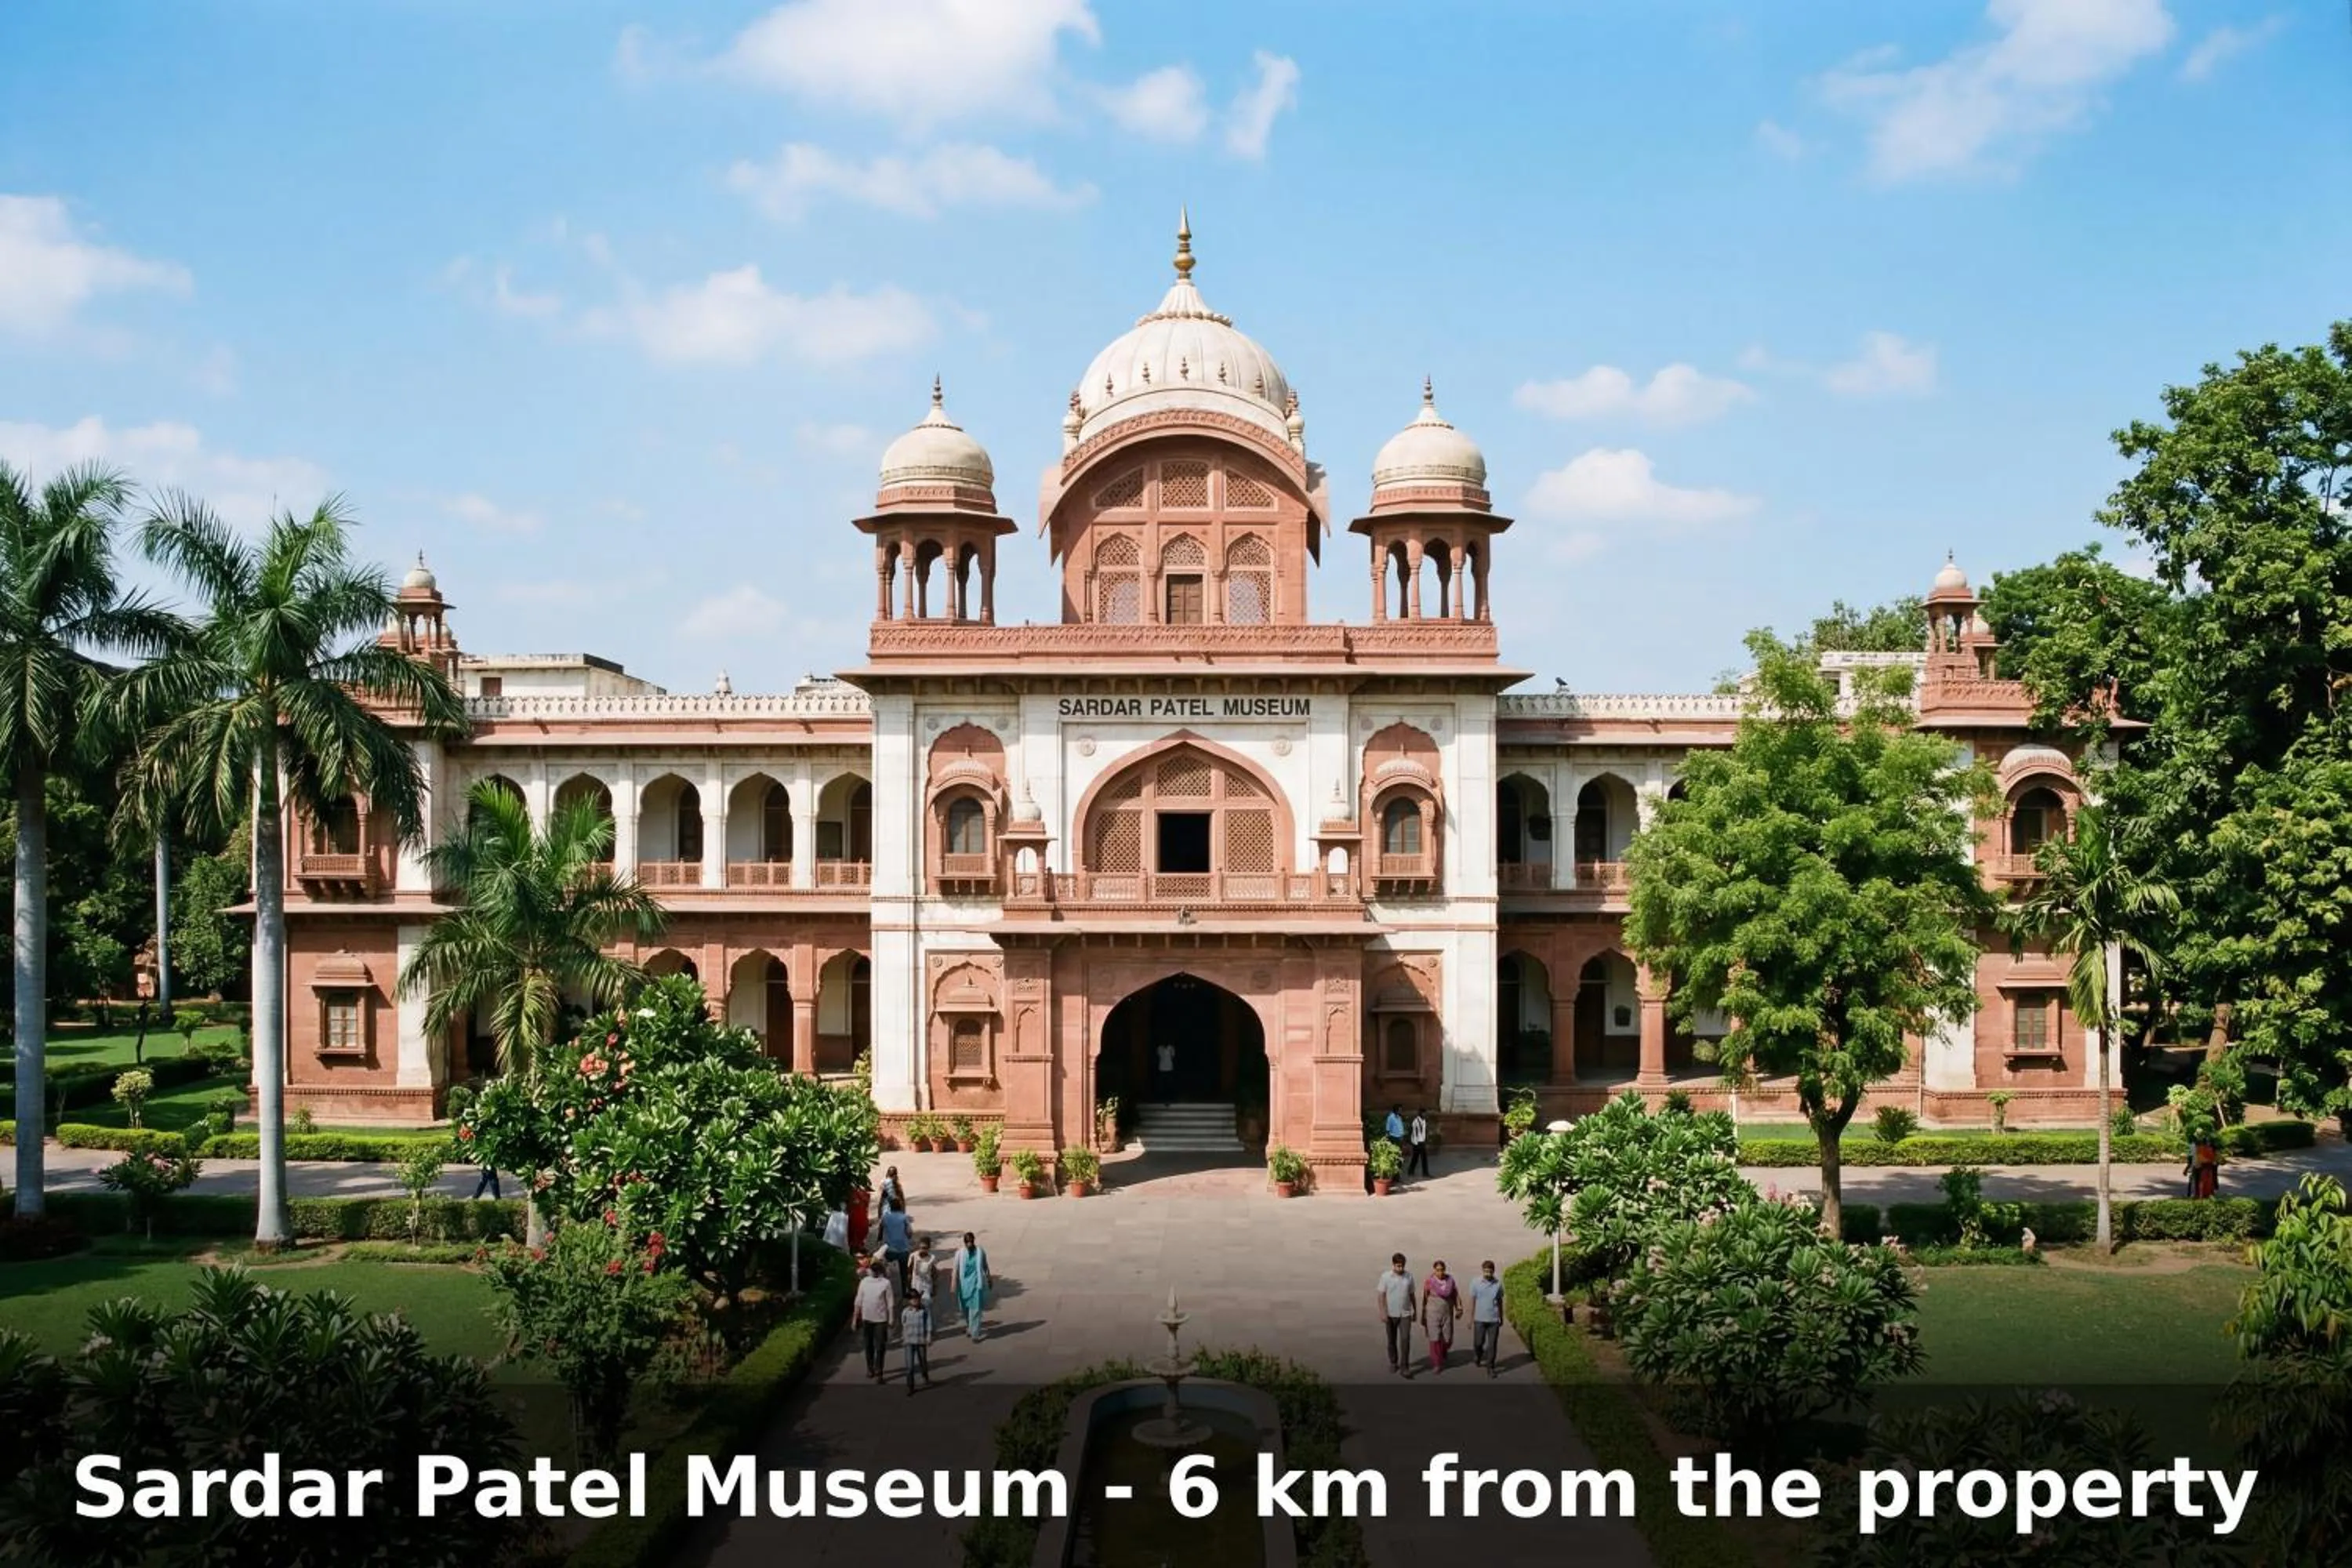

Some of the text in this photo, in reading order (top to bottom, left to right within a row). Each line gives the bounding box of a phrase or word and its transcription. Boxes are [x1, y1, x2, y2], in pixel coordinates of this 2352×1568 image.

[1059, 699, 1311, 716] SARDAR PATEL MUSEUM
